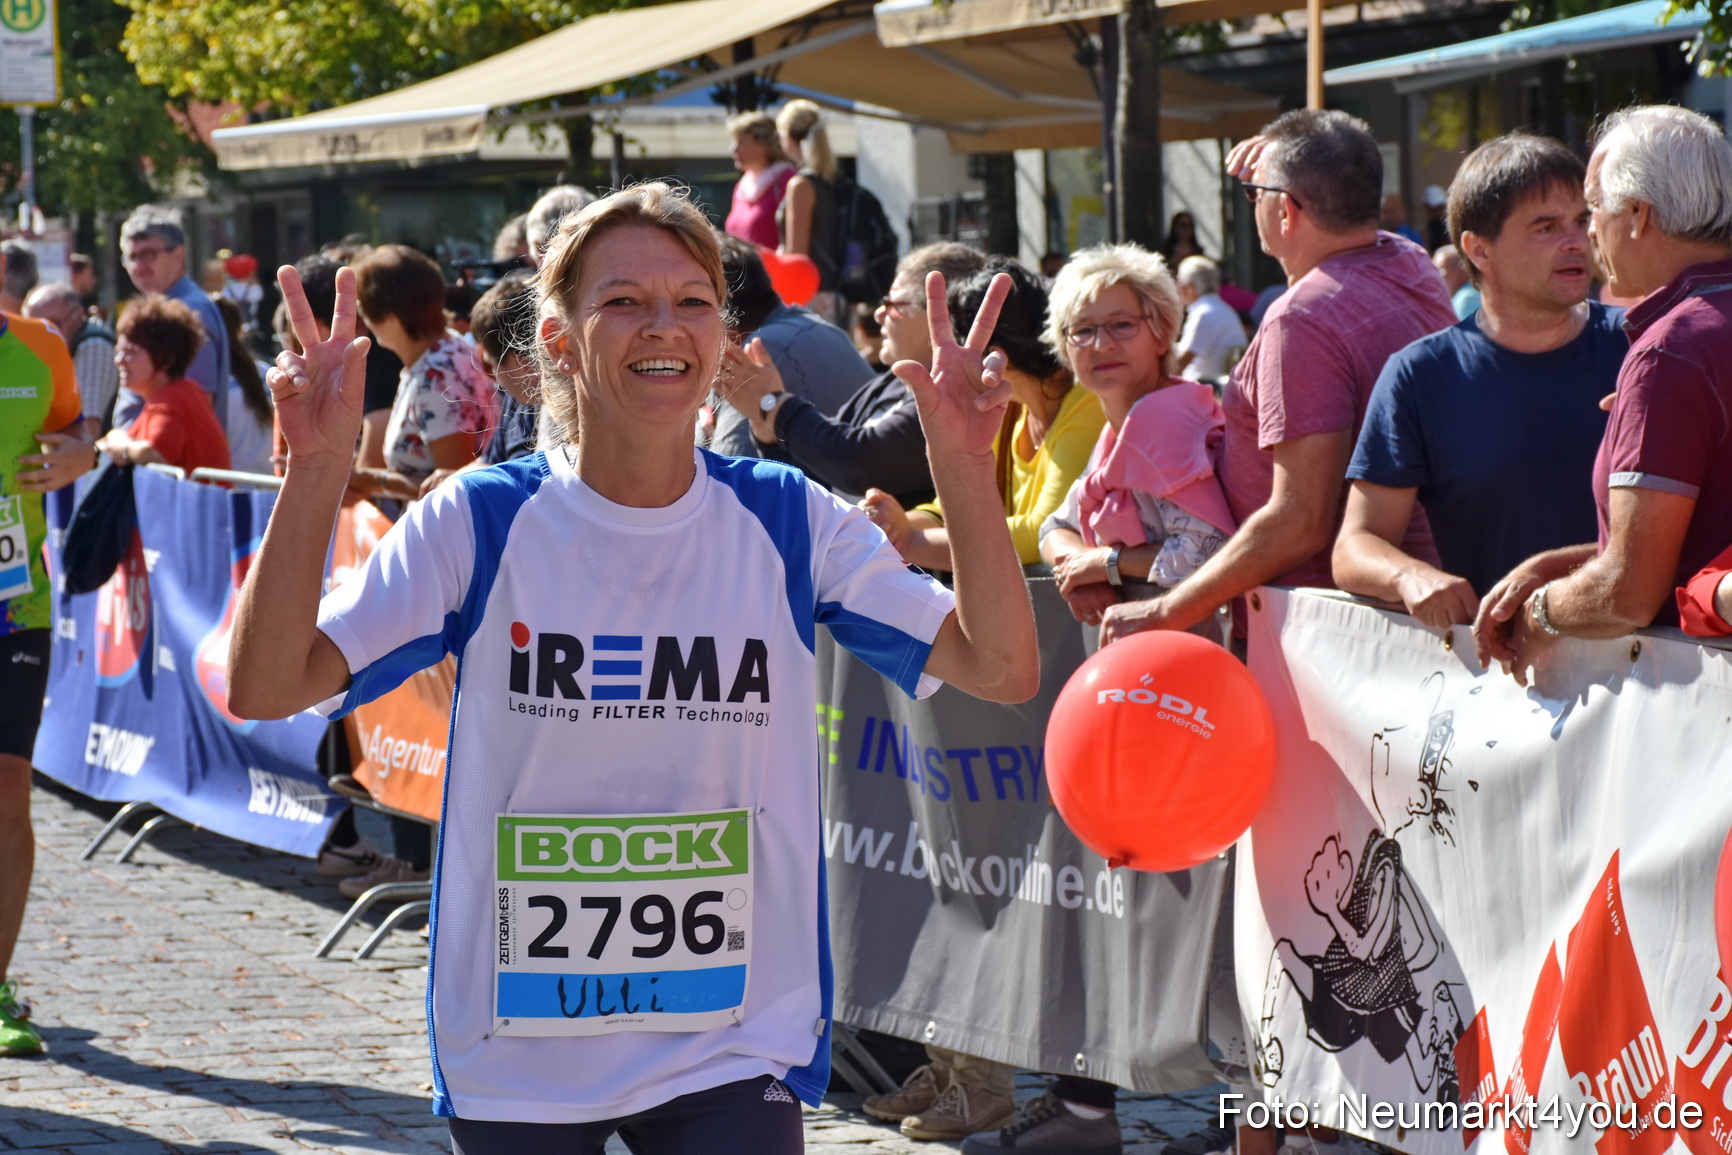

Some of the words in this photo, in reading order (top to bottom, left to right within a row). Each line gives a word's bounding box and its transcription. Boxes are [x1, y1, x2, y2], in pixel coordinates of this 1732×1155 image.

[509, 697, 579, 722] Leading
[593, 705, 665, 719] FILTER
[676, 706, 770, 727] Technology
[1156, 711, 1212, 740] energie
[515, 820, 733, 873] BOCK
[528, 891, 726, 961] 2796
